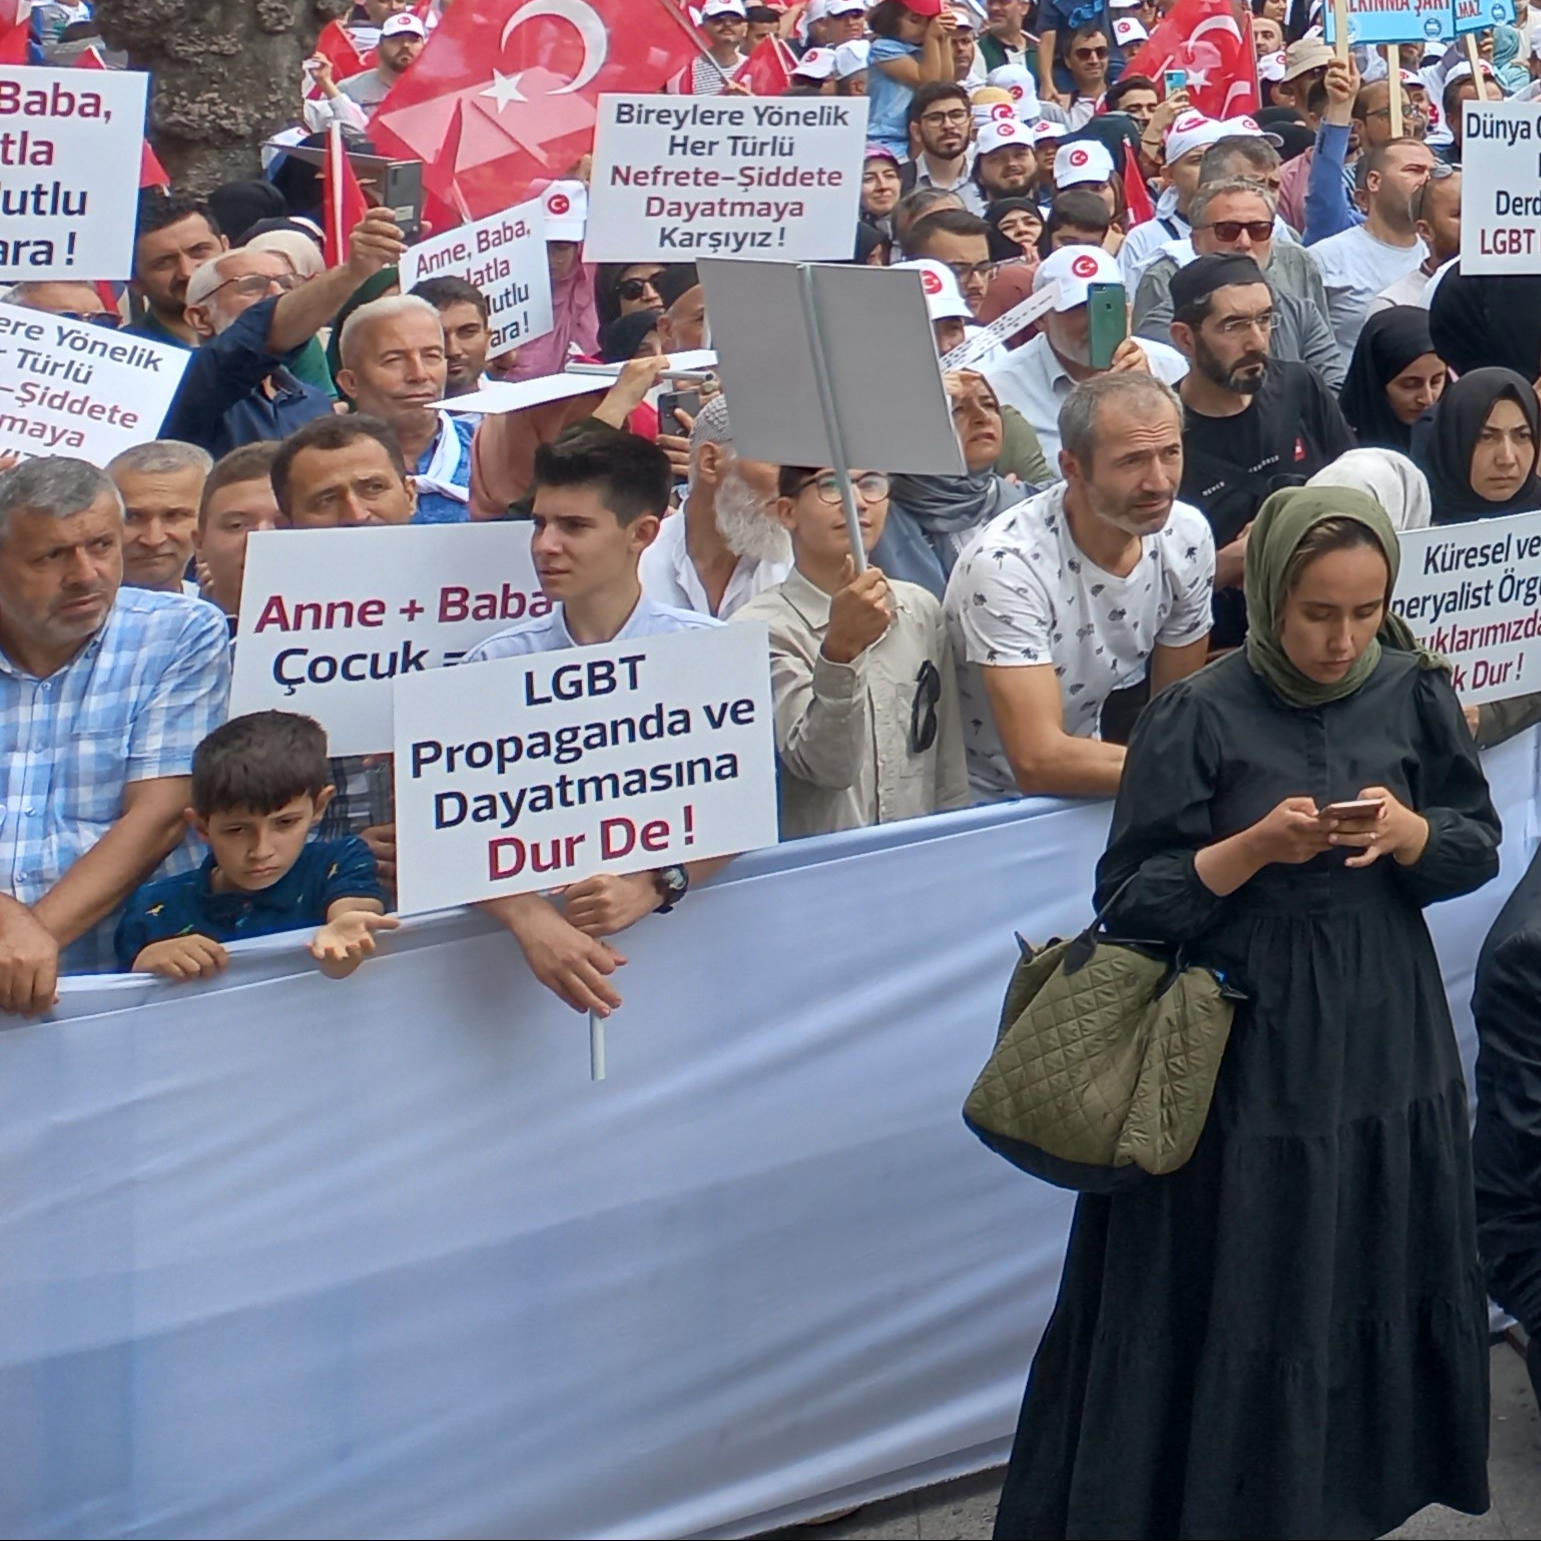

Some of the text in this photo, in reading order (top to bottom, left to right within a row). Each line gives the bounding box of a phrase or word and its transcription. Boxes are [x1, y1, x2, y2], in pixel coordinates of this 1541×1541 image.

[615, 103, 850, 130] Bireylere Yönelik
[1466, 113, 1531, 146] Dünya
[668, 135, 795, 156] Her Türlü
[645, 197, 804, 223] Dayatmaya
[416, 220, 530, 278] Anne, Baba,
[659, 227, 772, 253] Karşıyız
[1481, 229, 1535, 255] LGBT
[17, 348, 93, 385] Türlü
[56, 325, 163, 372] Yönelik
[1423, 533, 1541, 575] Küresel ve
[254, 594, 386, 634] Anne
[272, 641, 430, 696] Çocuk
[524, 654, 646, 706] LGBT
[1471, 660, 1513, 691] Dur
[411, 696, 756, 779] Propaganda ve
[433, 752, 739, 830] Dayatmasına
[488, 833, 587, 882] Dur
[600, 816, 670, 861] De
